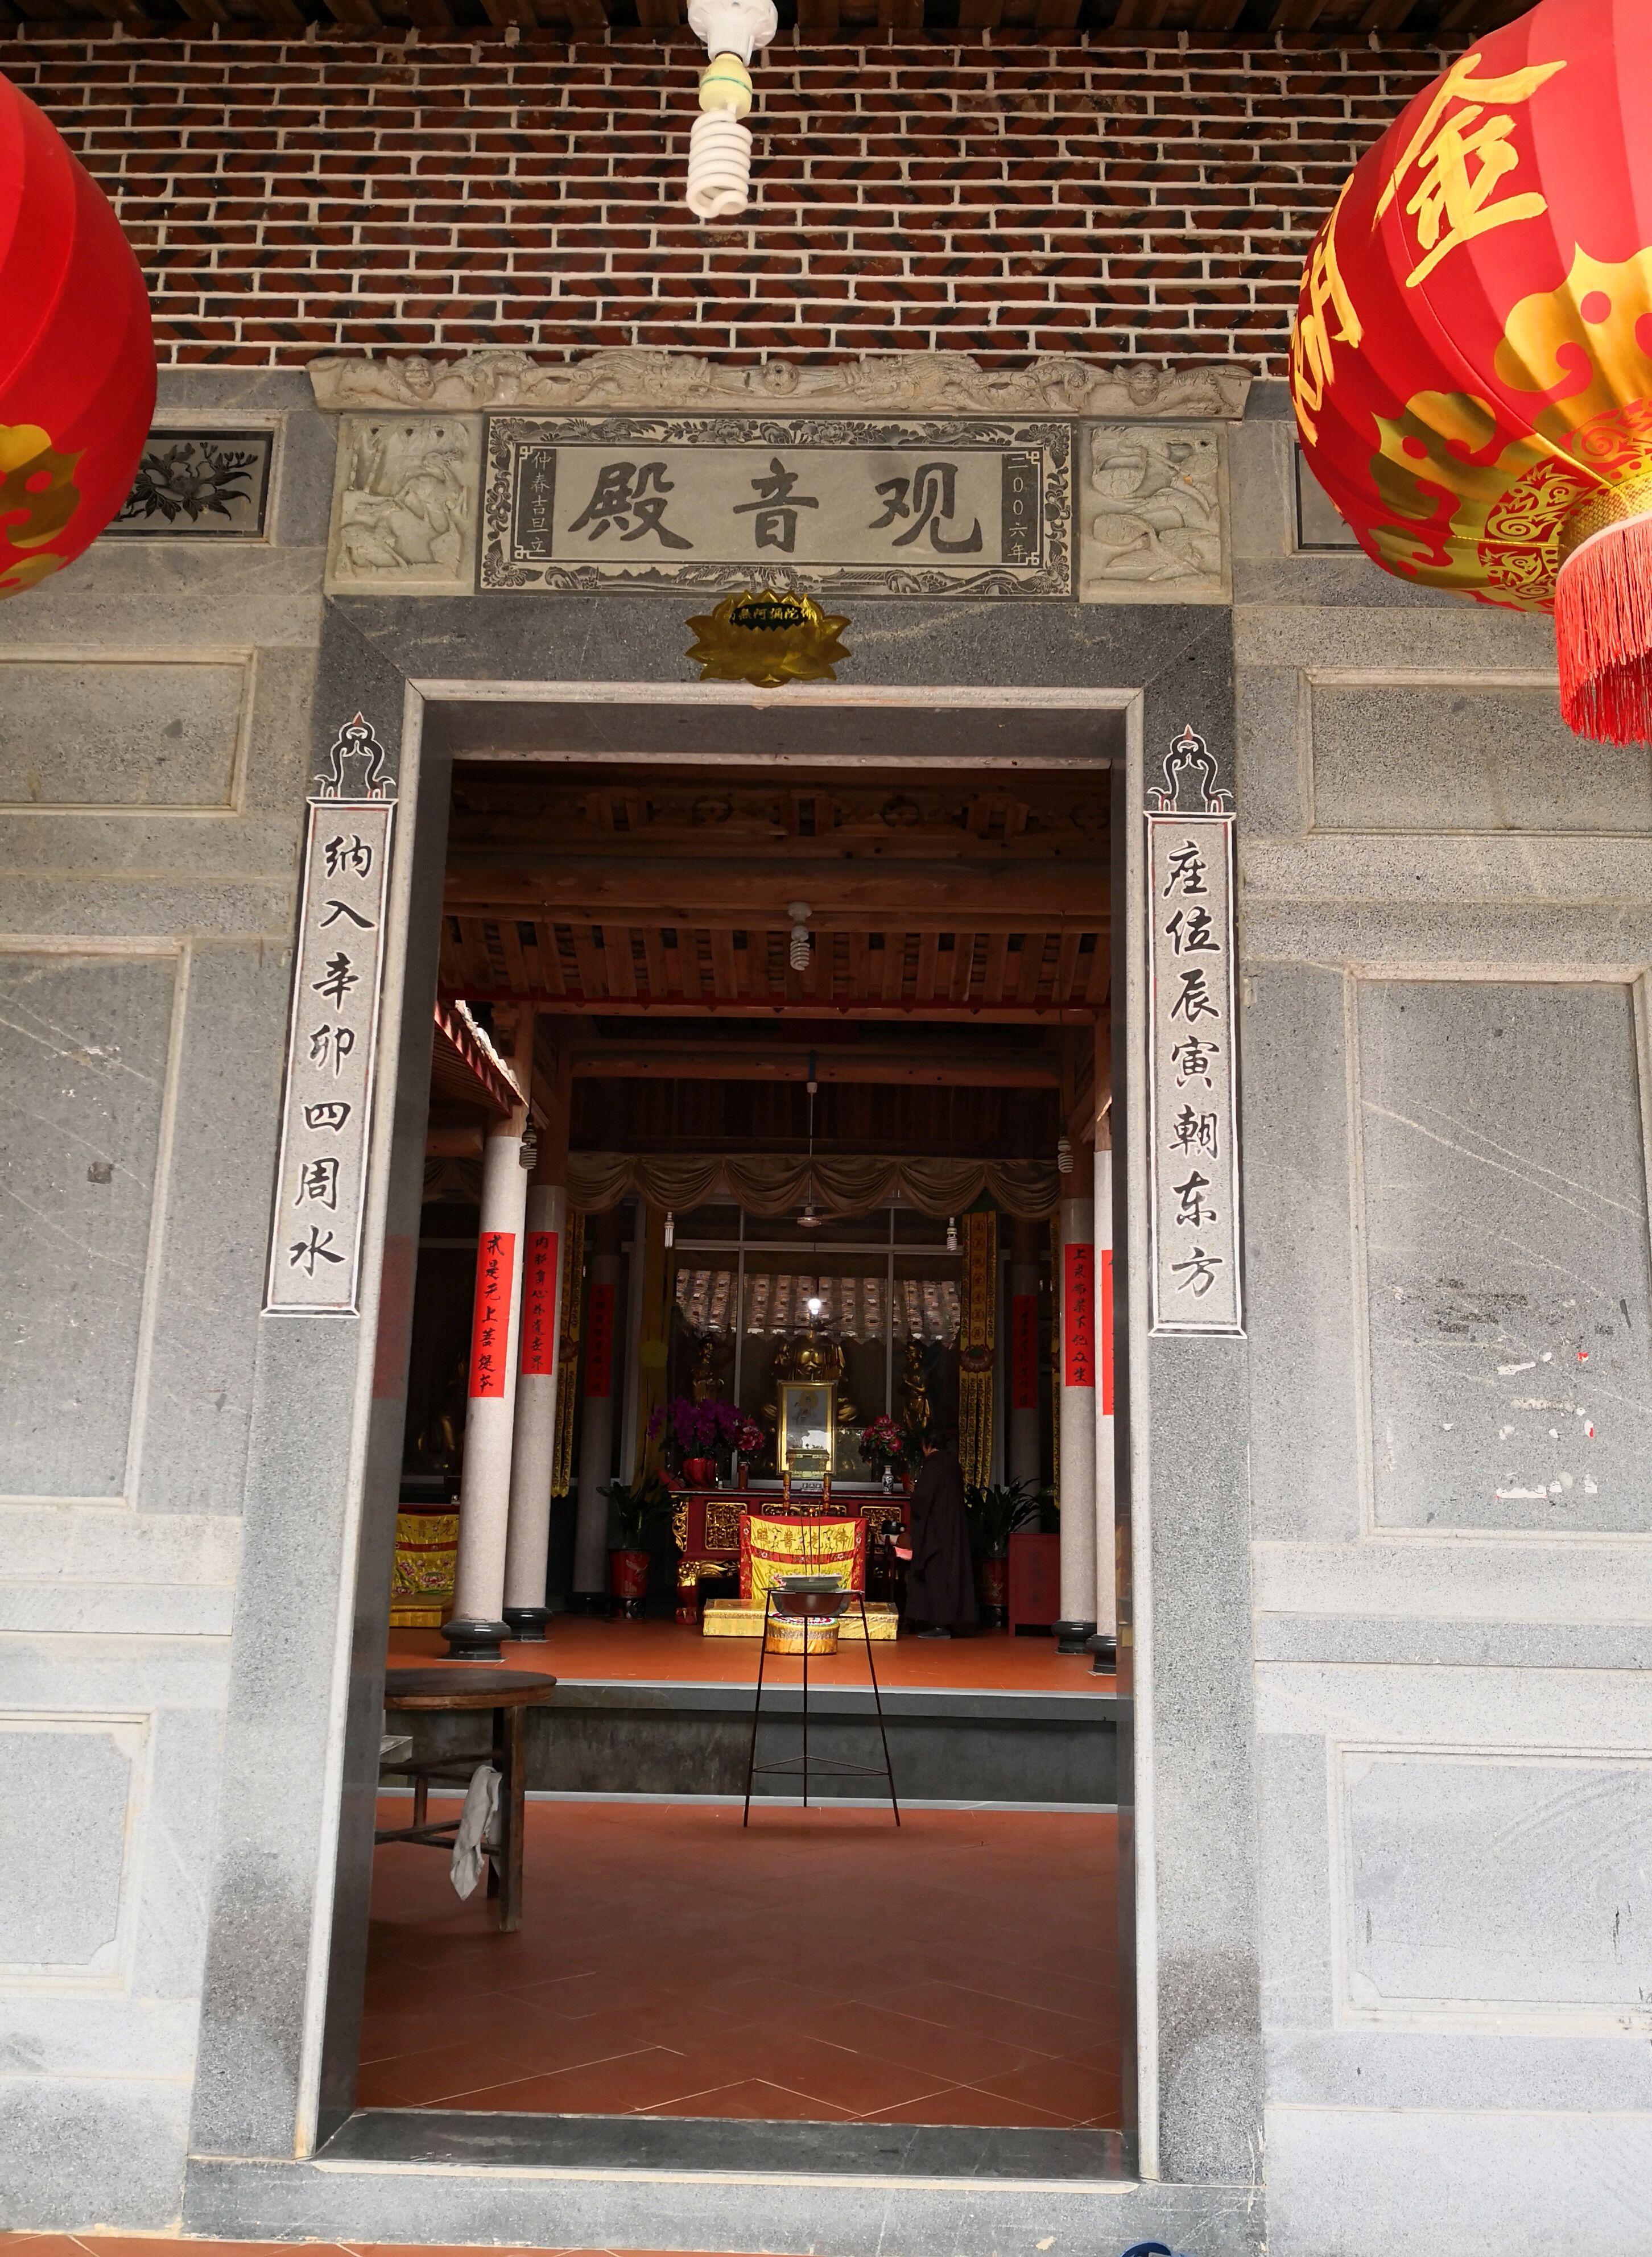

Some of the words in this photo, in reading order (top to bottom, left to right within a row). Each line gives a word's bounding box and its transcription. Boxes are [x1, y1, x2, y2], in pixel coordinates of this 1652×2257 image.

[1372, 53, 1567, 288] 金
[526, 451, 552, 552] 仲春吉旦立
